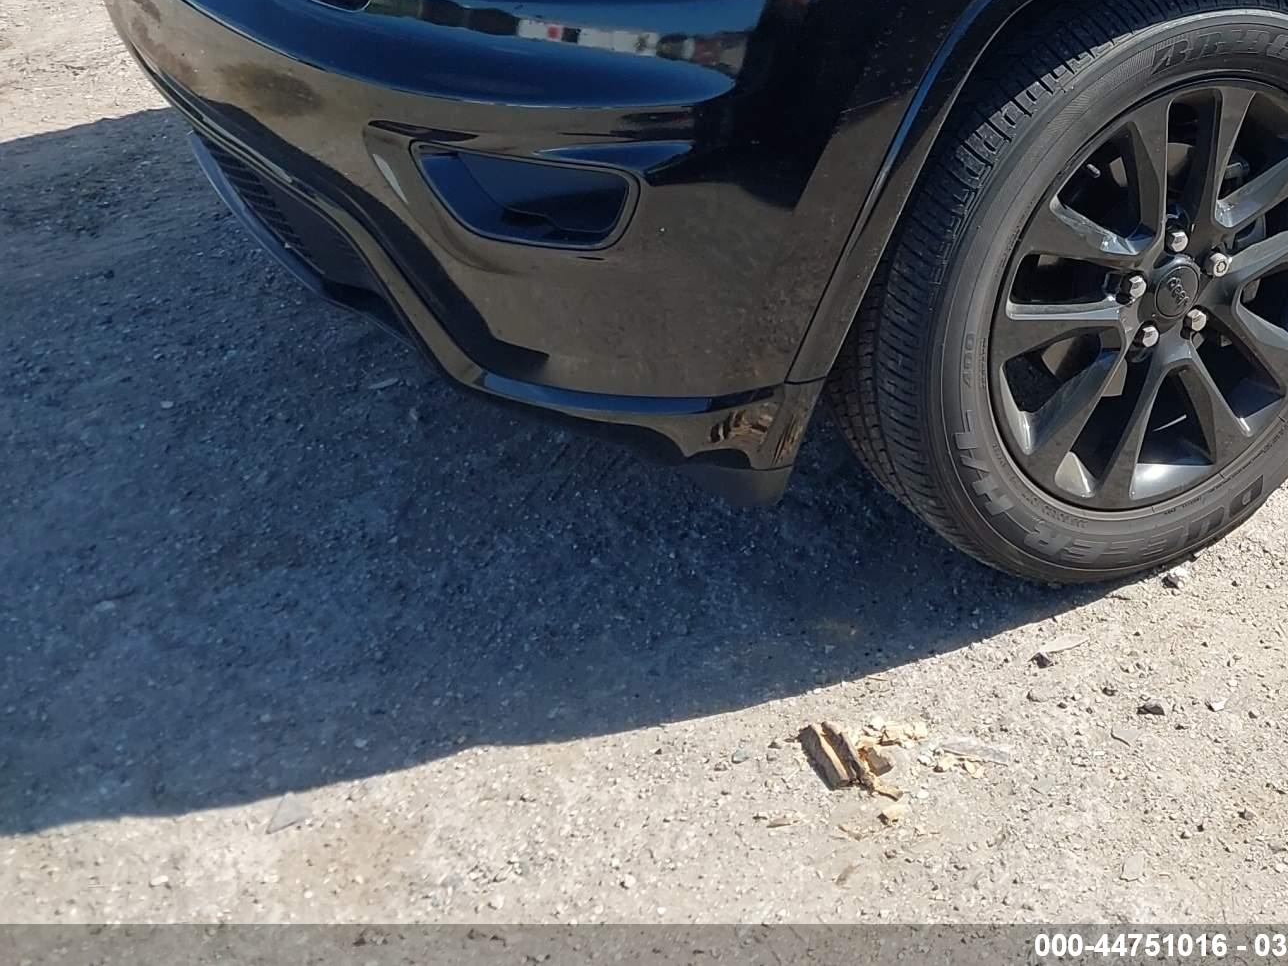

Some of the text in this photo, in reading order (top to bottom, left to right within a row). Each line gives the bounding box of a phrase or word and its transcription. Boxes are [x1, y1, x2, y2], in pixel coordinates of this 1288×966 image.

[1166, 277, 1190, 308] Jeep
[962, 332, 976, 389] 400
[1023, 474, 1265, 565] DUELER
